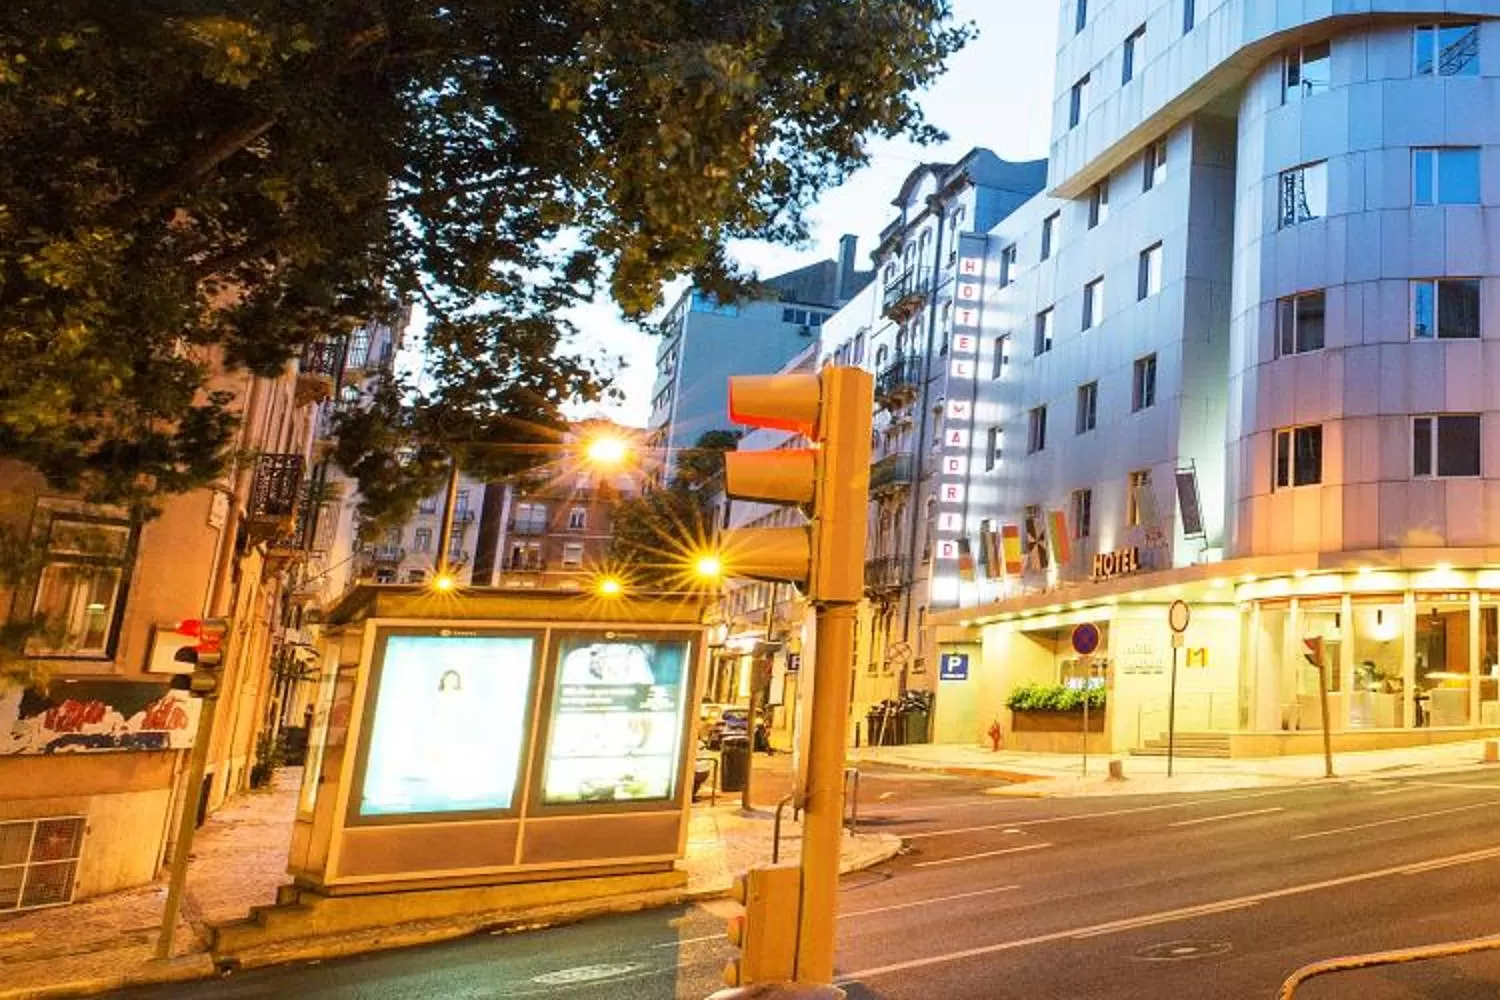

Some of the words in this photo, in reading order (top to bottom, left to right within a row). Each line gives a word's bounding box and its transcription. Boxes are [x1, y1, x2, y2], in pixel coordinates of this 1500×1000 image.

[942, 404, 966, 556] MADRID
[1092, 546, 1140, 579] HOTEL
[947, 655, 962, 673] P
